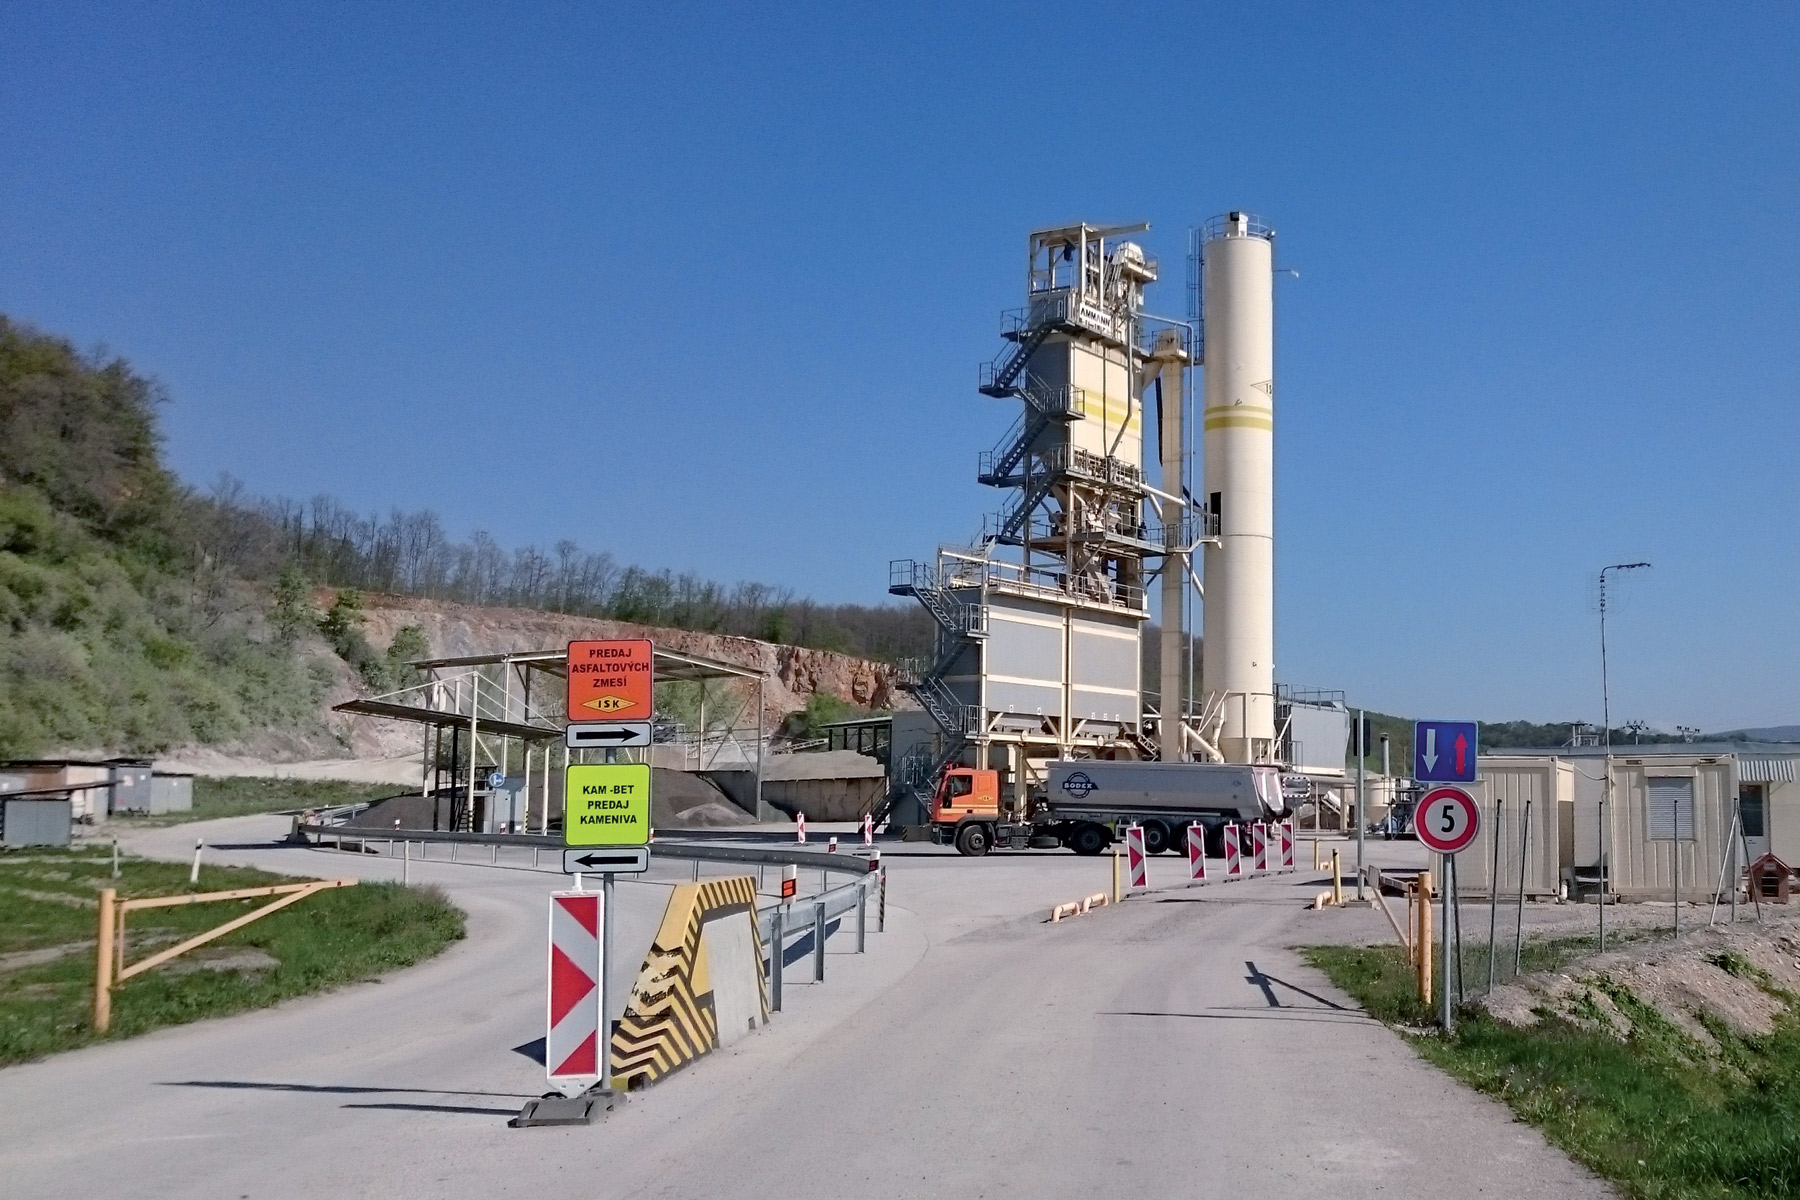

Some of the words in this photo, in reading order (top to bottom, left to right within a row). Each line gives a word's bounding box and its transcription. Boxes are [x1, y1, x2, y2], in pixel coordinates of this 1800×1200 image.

[1080, 307, 1110, 327] AMMANN
[589, 648, 632, 658] PREDAJ
[572, 660, 649, 673] ASFALTOVÝCH
[592, 675, 627, 688] ZMESÍ
[598, 700, 620, 708] ISK
[582, 785, 607, 794] KAM
[587, 800, 629, 809] PREDAJ
[580, 815, 637, 824] KAMENIVA
[1440, 804, 1455, 833] 5
